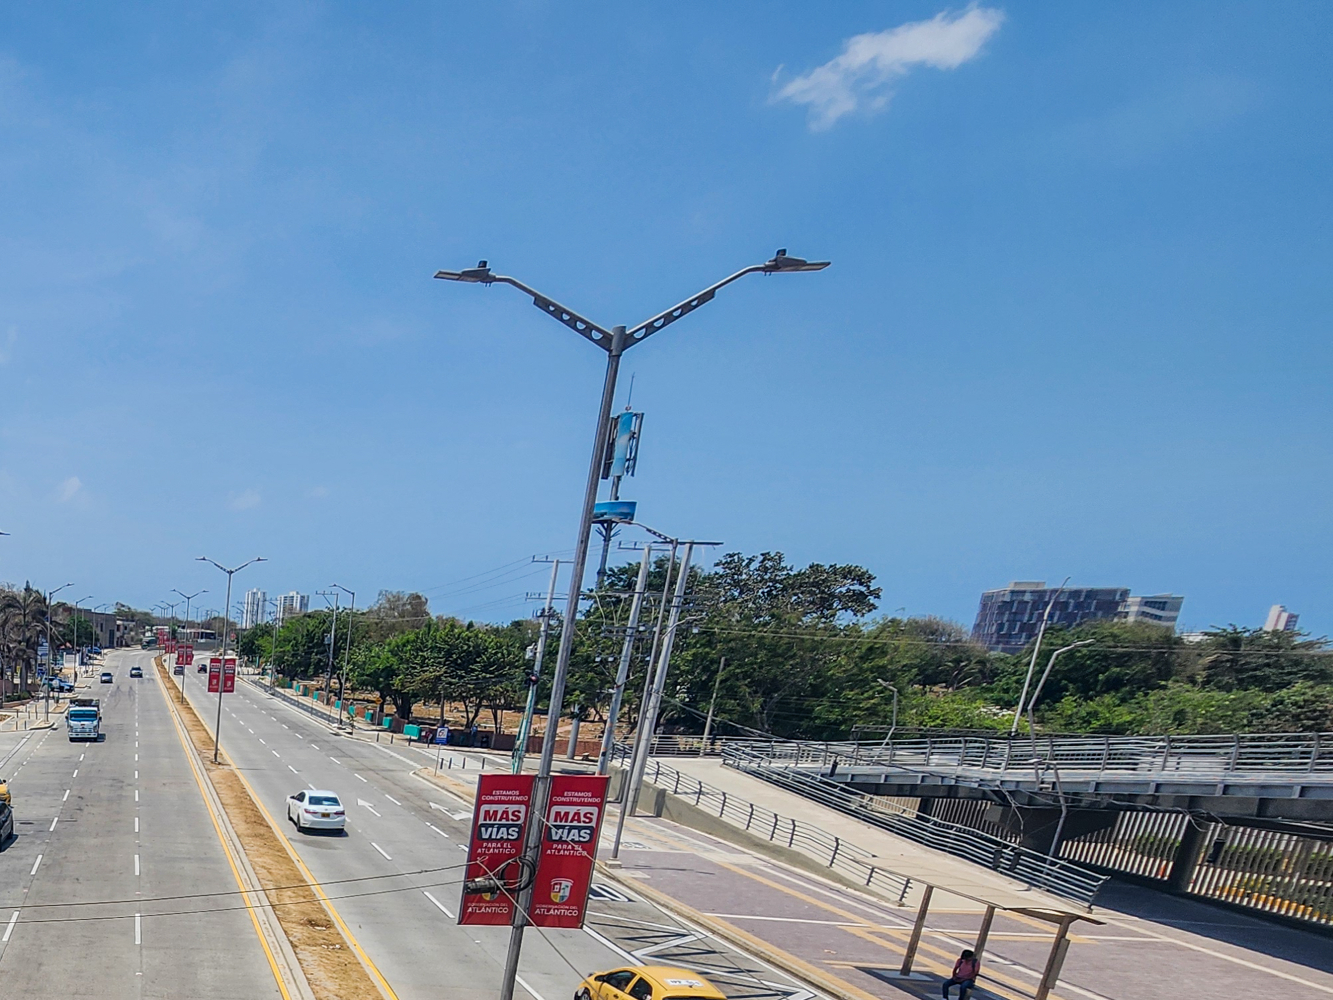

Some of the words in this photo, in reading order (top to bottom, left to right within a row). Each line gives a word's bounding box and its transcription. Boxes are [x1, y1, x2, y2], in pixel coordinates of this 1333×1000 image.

[483, 807, 522, 822] MÁS
[553, 809, 595, 824] MÁS
[480, 825, 519, 840] VÍAS
[550, 826, 591, 842] VÍAS
[546, 849, 588, 857] ATLÁNTICO
[466, 906, 509, 914] ATLÁNTICO
[534, 908, 579, 917] ATLÁNTICO
